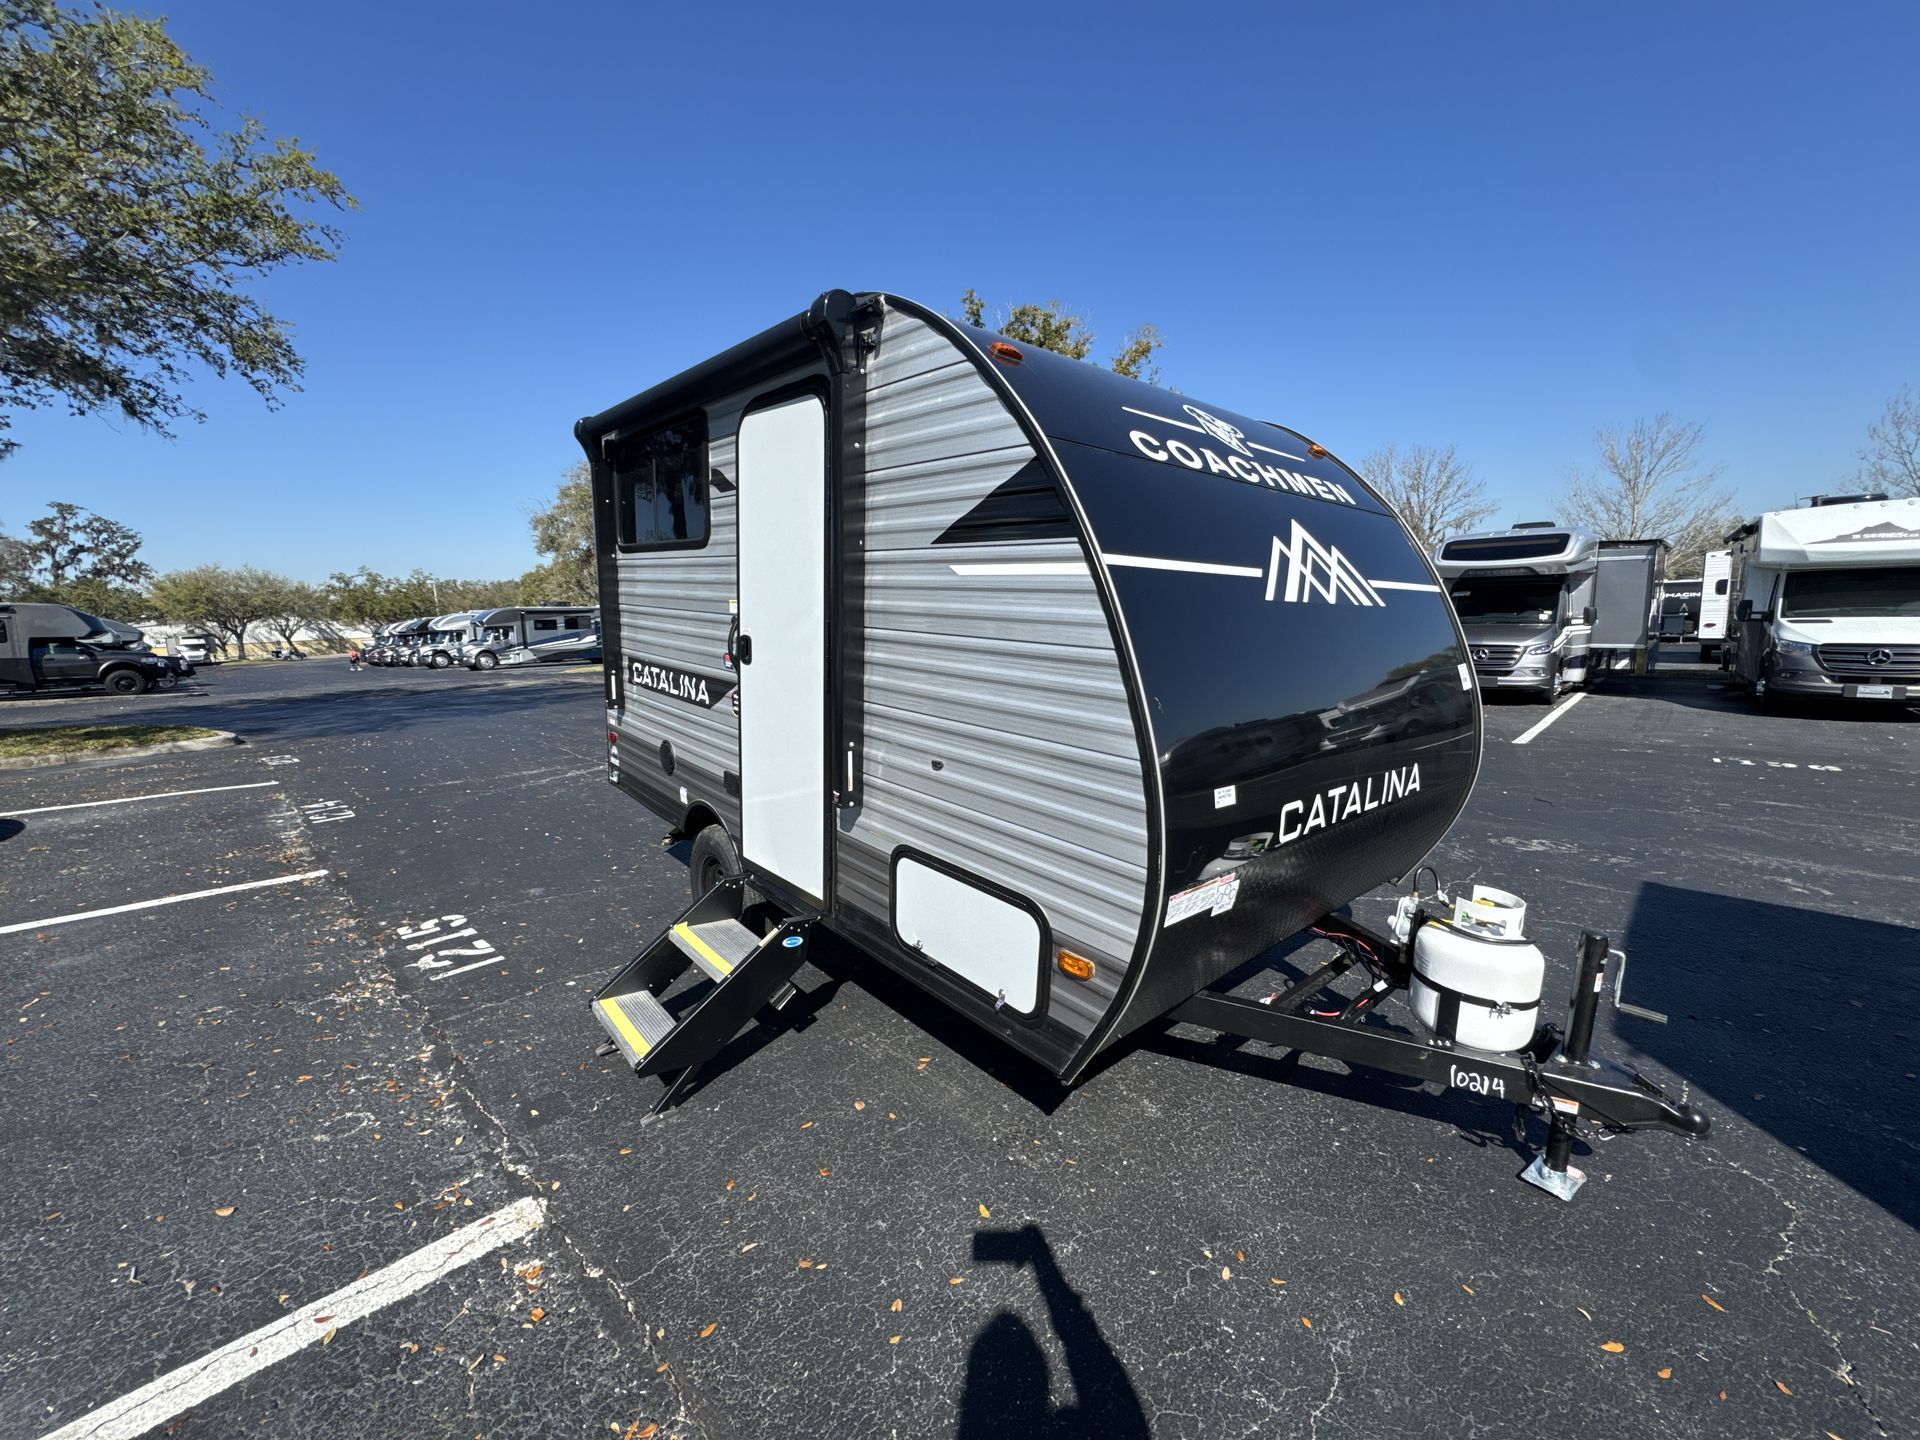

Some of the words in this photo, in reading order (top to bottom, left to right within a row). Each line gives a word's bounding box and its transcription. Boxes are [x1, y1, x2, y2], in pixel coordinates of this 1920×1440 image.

[1129, 430, 1356, 505] COACHMEN
[632, 662, 710, 705] CATALINA
[1279, 762, 1421, 844] CATALINA
[396, 914, 505, 981] 1215
[1450, 1064, 1506, 1099] 10214
